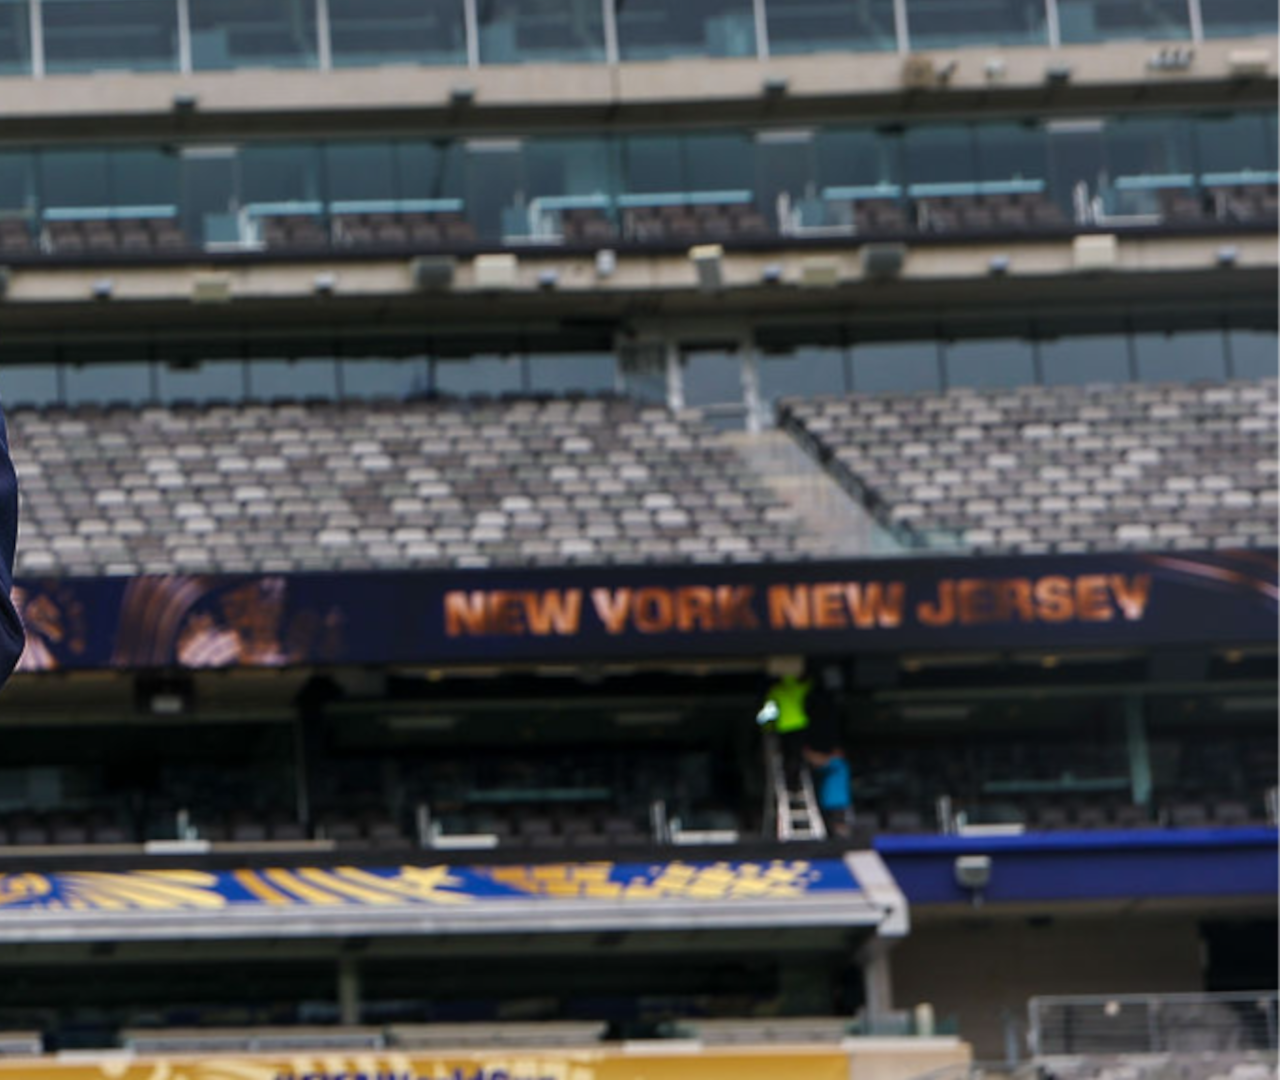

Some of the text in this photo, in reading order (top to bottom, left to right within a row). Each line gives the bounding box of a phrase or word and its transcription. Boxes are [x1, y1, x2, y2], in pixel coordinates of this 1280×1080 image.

[444, 573, 1154, 638] NEW YORK NEW JERSEY
